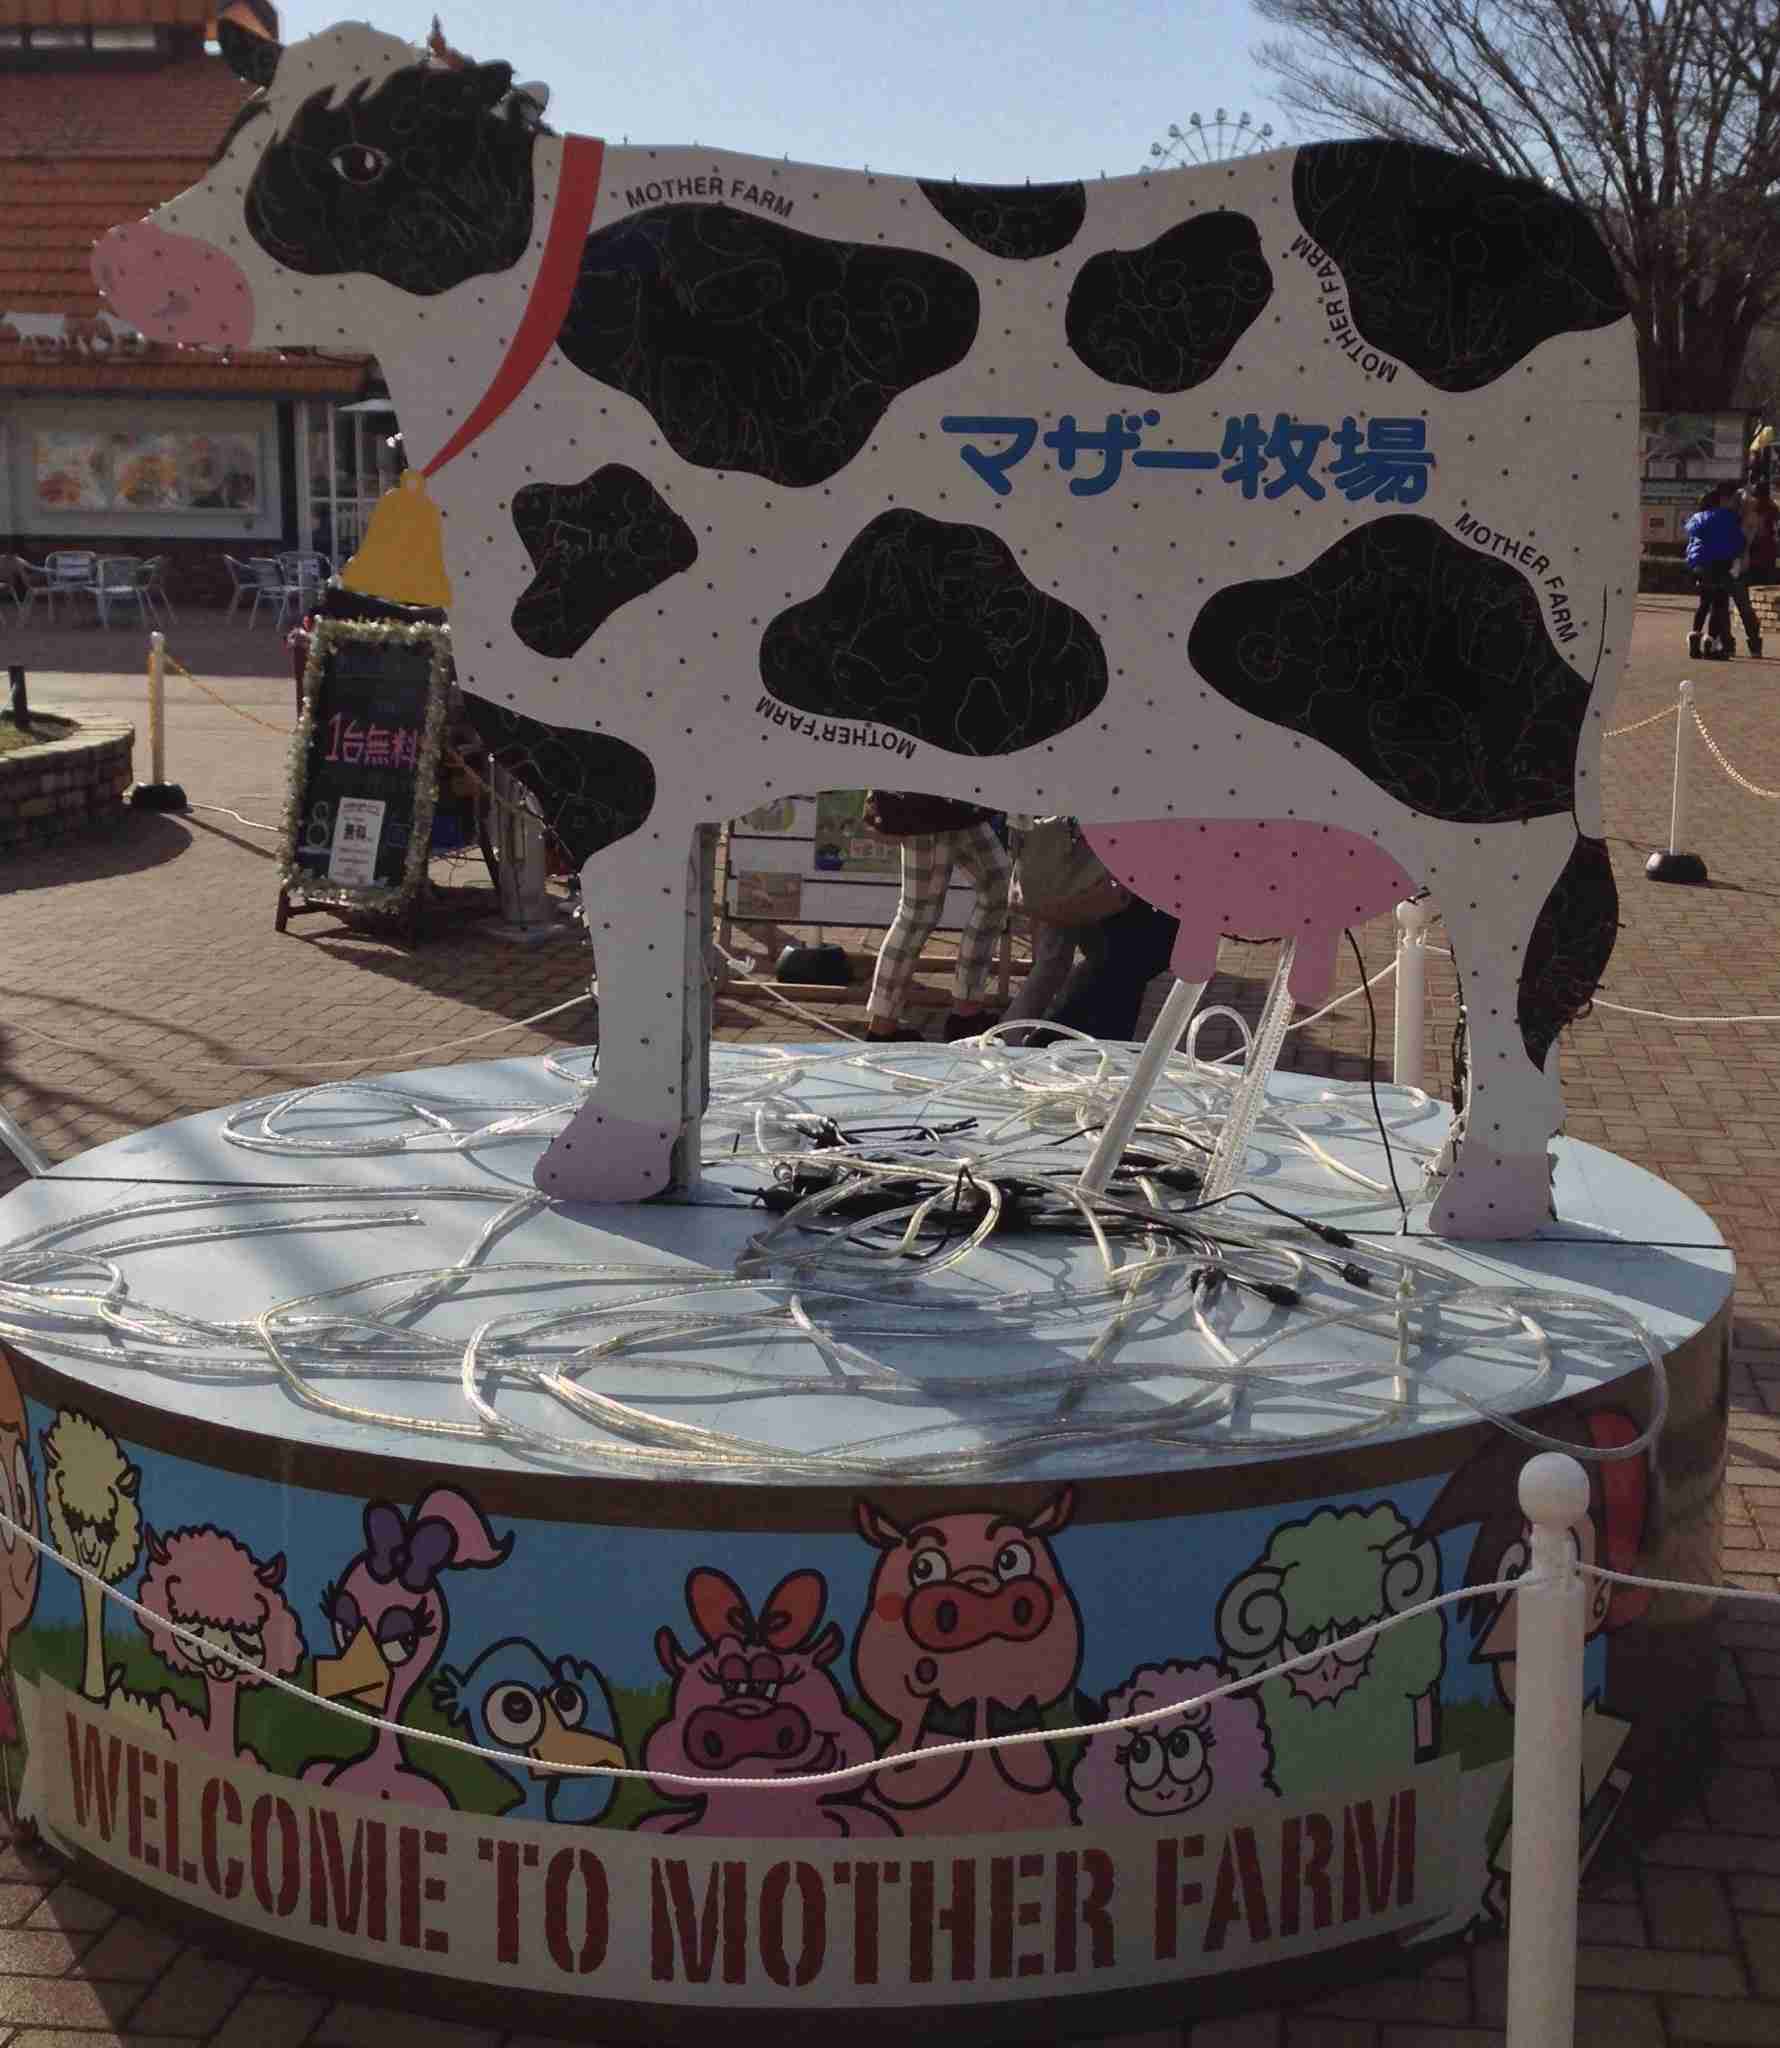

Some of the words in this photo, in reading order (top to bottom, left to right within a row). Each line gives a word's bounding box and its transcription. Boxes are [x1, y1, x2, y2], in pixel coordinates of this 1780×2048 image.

[626, 176, 723, 208] MOTHER
[731, 181, 793, 217] FARM
[1291, 234, 1339, 293] FARM
[1326, 300, 1398, 383] MOTHER
[940, 408, 1435, 504] マザー牧場
[1455, 512, 1549, 576] MOTHER
[1544, 576, 1578, 643] FARM
[755, 696, 816, 736] FARM
[822, 723, 916, 759] MOTHER
[66, 1710, 449, 1953] WELCOME
[478, 1837, 609, 1975] TO
[651, 1848, 1116, 1987] MOTHER
[1153, 1789, 1416, 1960] FARM
